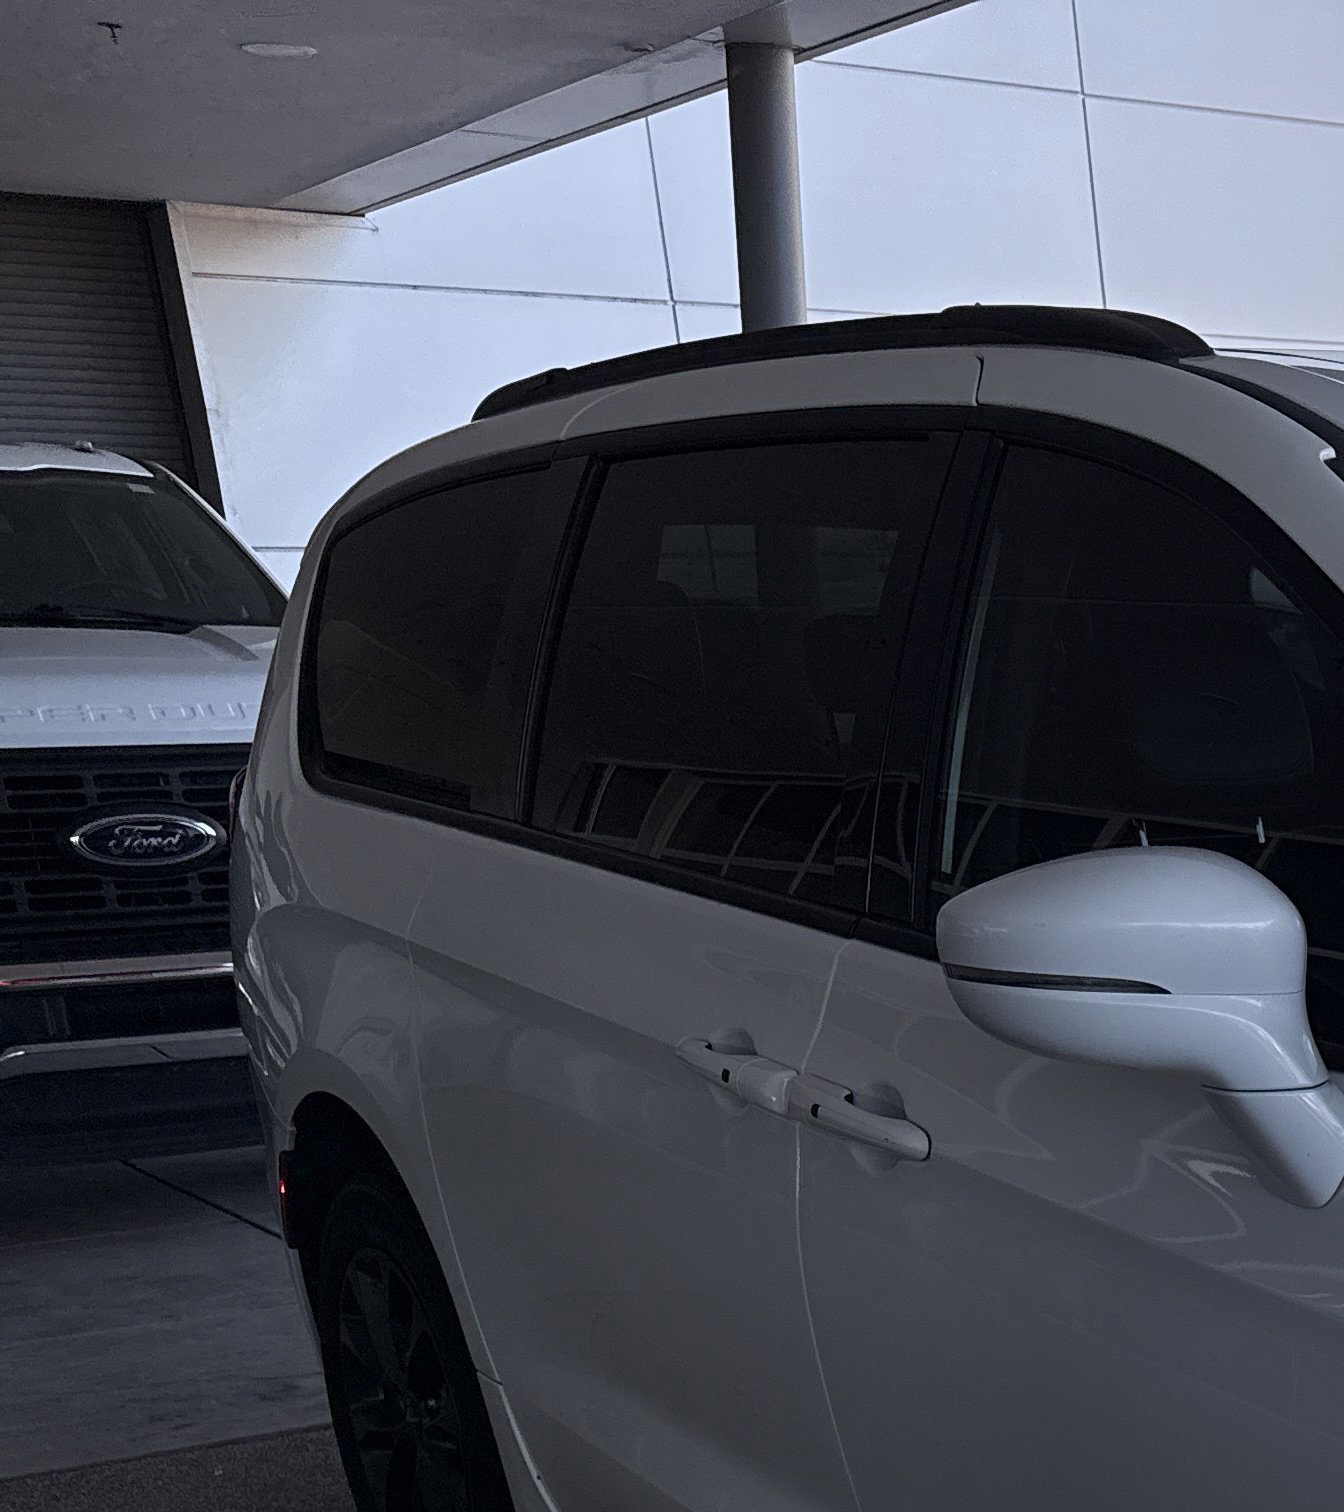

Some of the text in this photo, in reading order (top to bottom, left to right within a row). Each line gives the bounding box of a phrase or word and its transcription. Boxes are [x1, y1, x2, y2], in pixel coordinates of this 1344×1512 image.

[0, 703, 248, 723] PER DU
[107, 825, 184, 855] Ford
